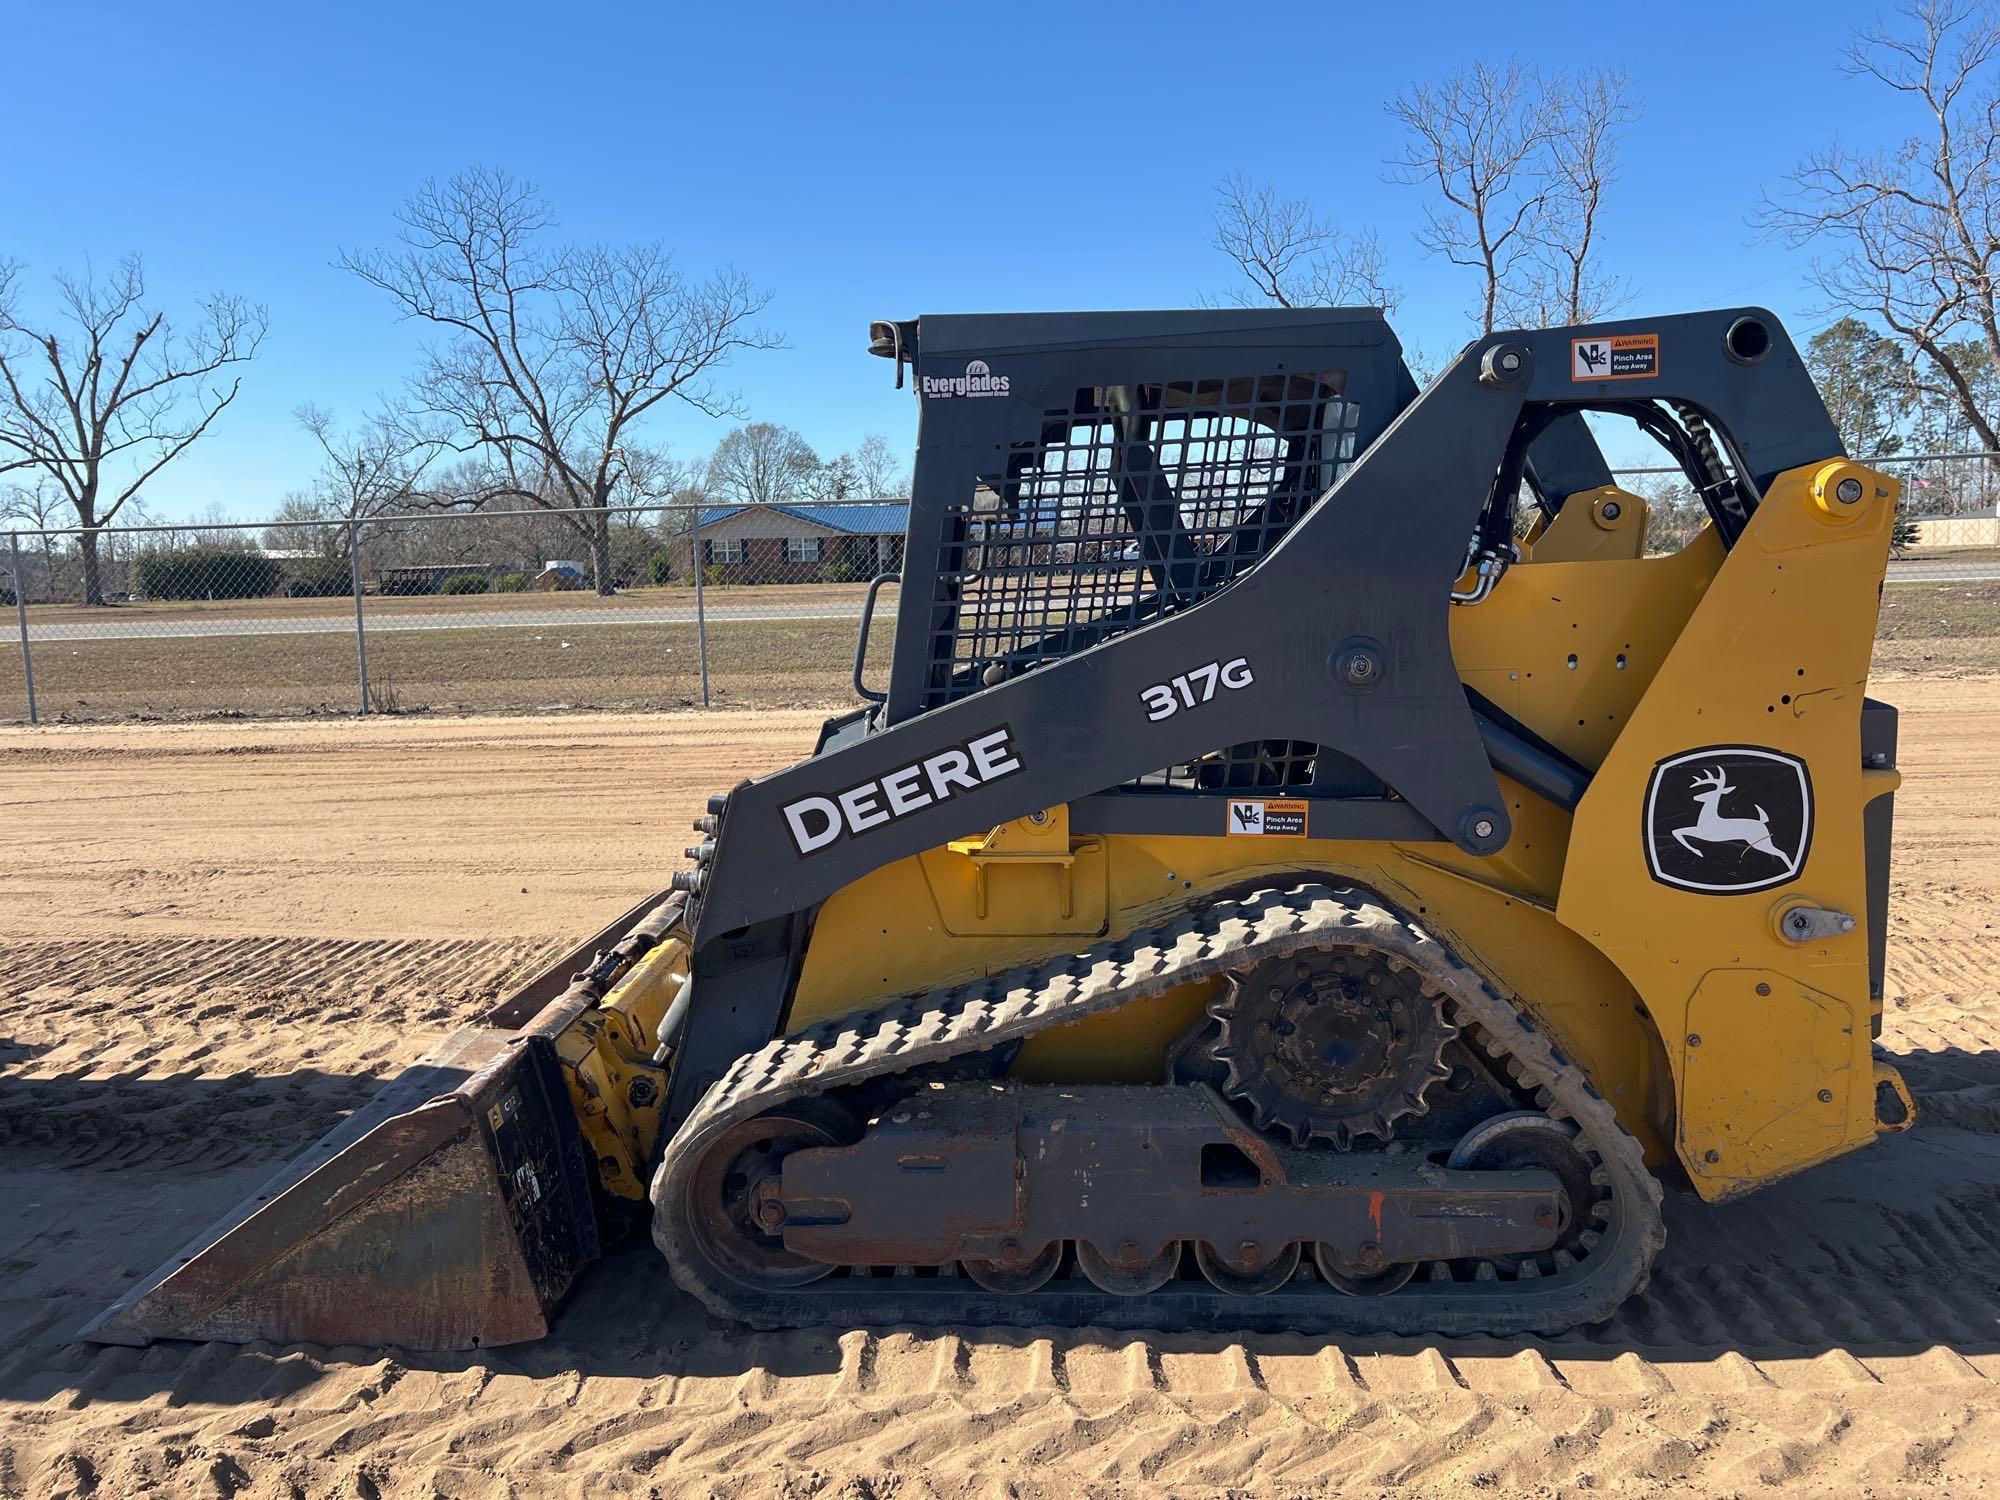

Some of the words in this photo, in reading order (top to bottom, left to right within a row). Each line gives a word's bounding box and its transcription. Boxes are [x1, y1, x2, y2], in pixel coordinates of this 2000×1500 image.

[1613, 354, 1634, 362] Pinch
[923, 374, 1010, 396] Everglades
[1141, 658, 1254, 721] 317G
[783, 729, 1021, 854] DEERE
